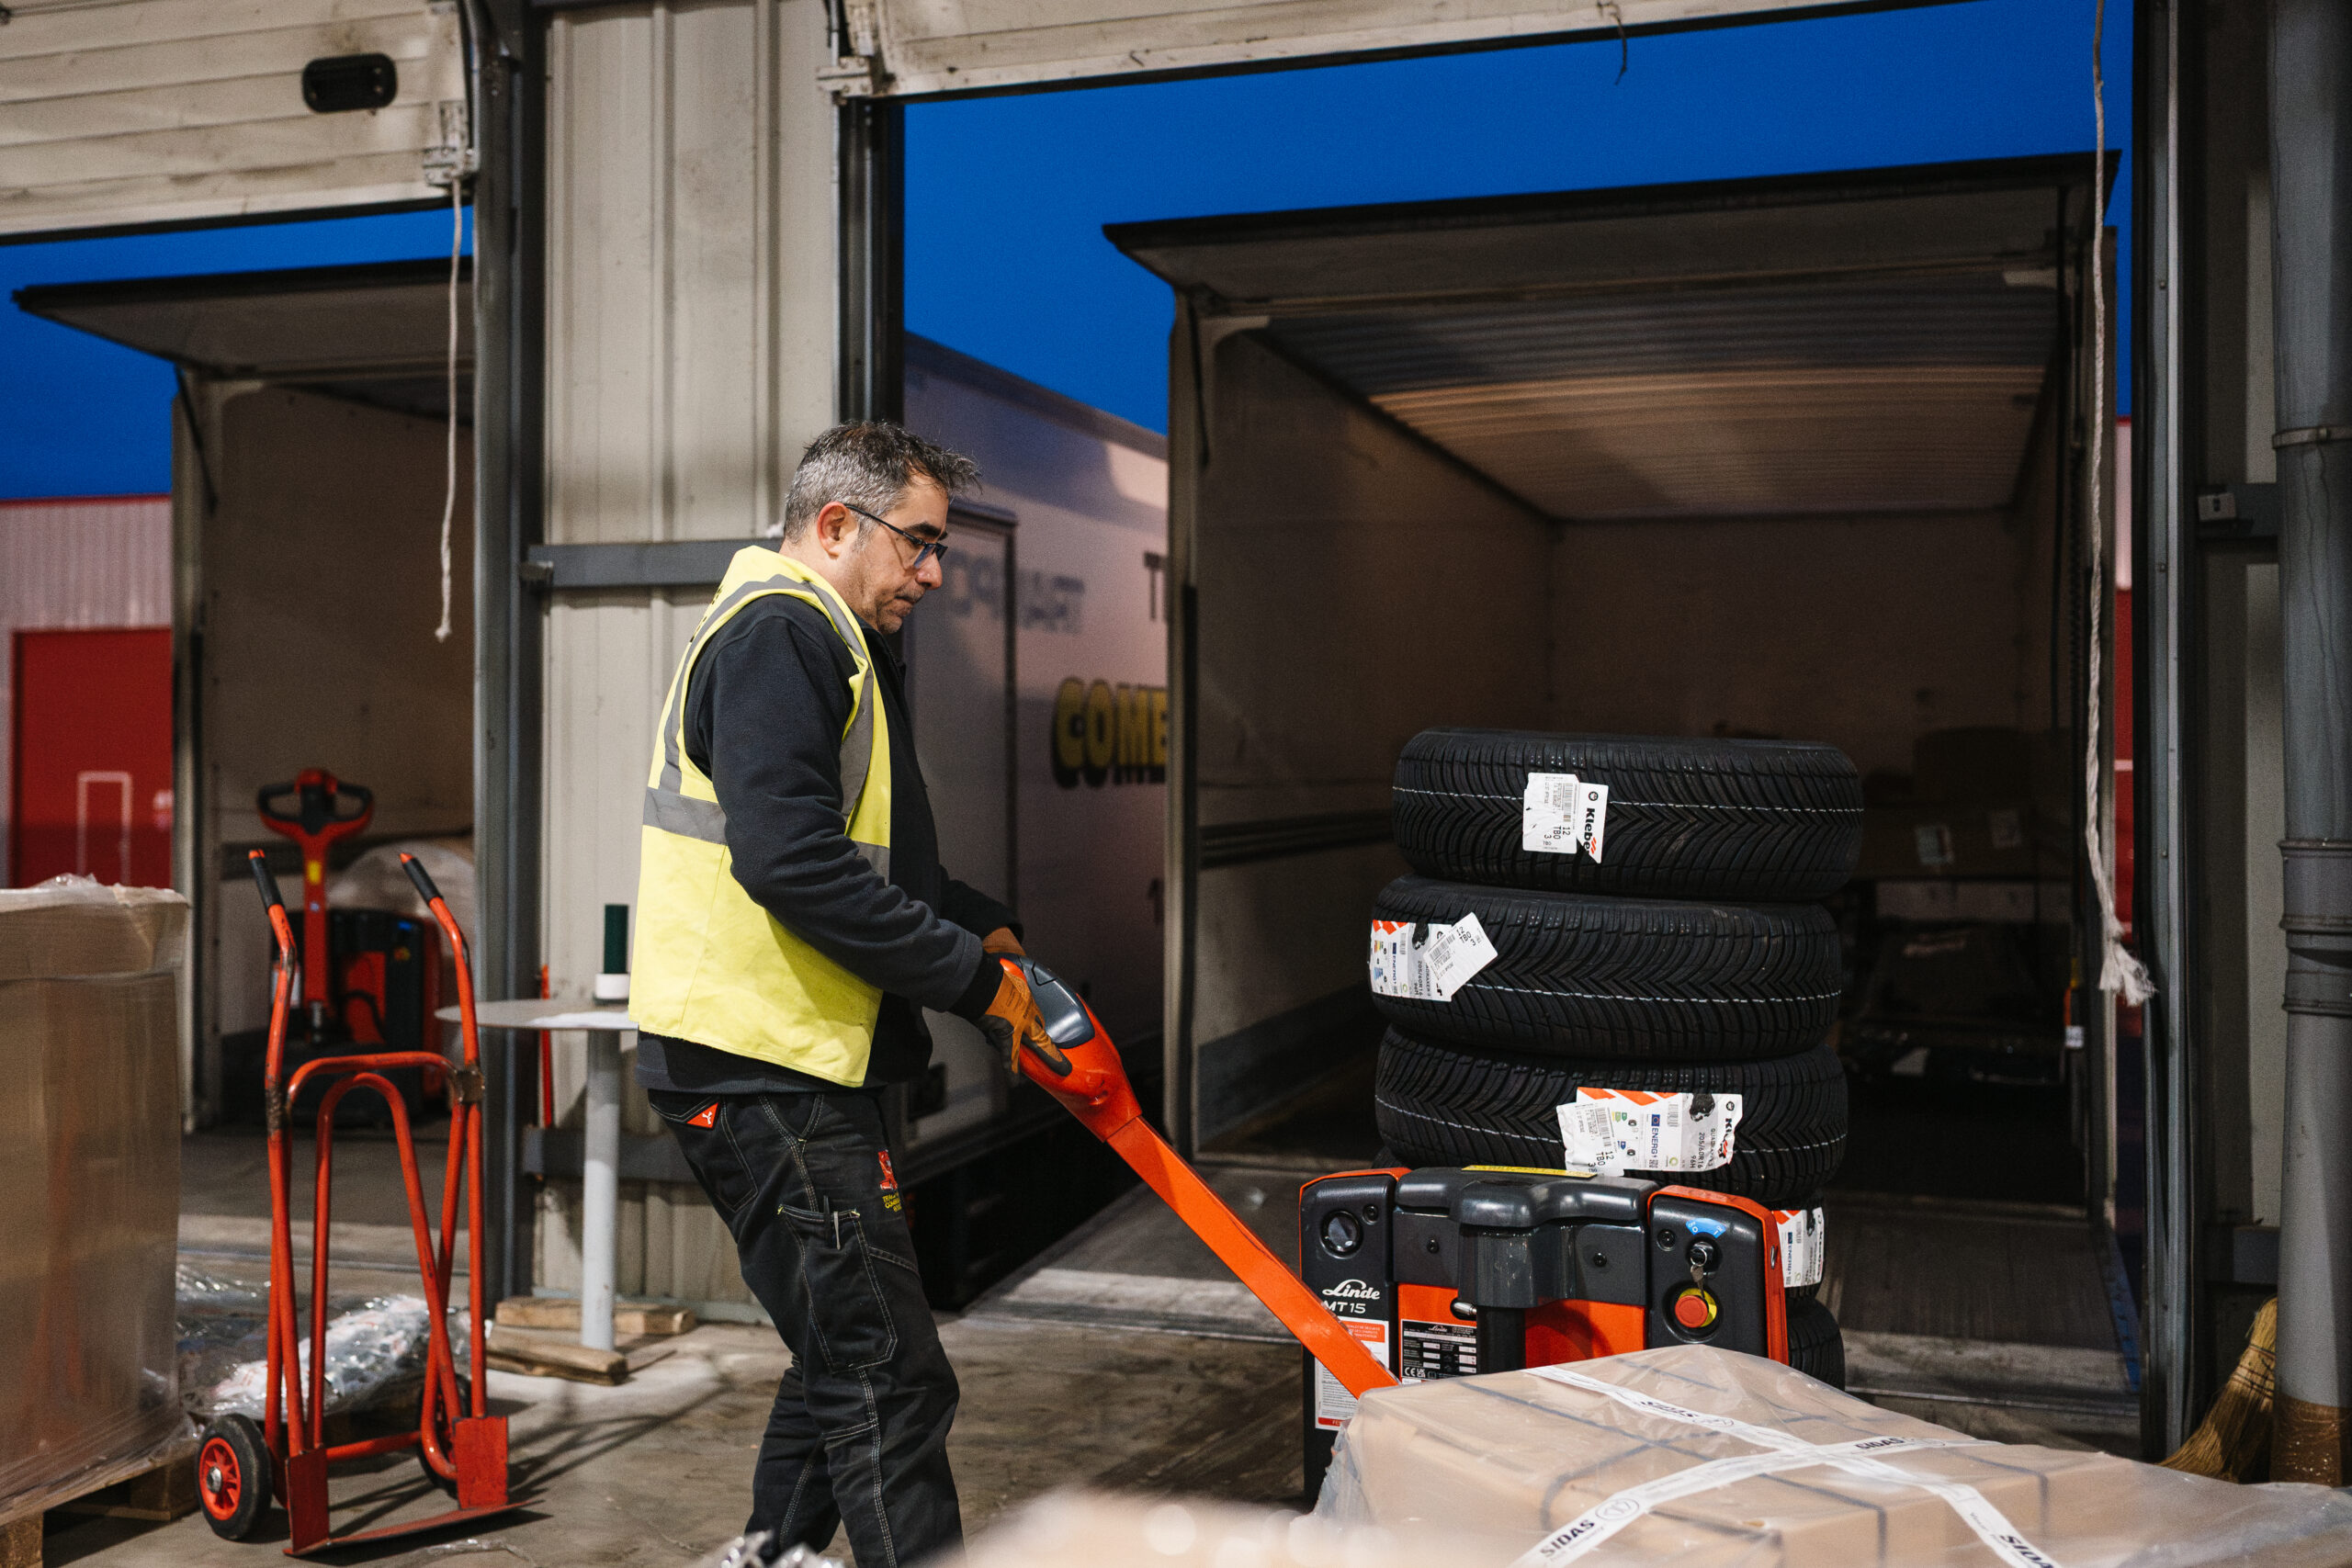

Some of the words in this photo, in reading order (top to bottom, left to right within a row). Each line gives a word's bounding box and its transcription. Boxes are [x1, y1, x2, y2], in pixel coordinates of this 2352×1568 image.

[1563, 826, 1571, 836] 12
[1584, 807, 1596, 851] Klebe
[1651, 1128, 1659, 1155] ENERG
[1697, 1132, 1705, 1168] 205/60R16
[1605, 1151, 1614, 1160] 12
[1322, 1279, 1381, 1301] Linde
[1323, 1300, 1349, 1314] MT
[1350, 1303, 1367, 1314] 15
[1854, 1437, 1905, 1450] SIDAS
[1540, 1518, 1596, 1558] SIDAS
